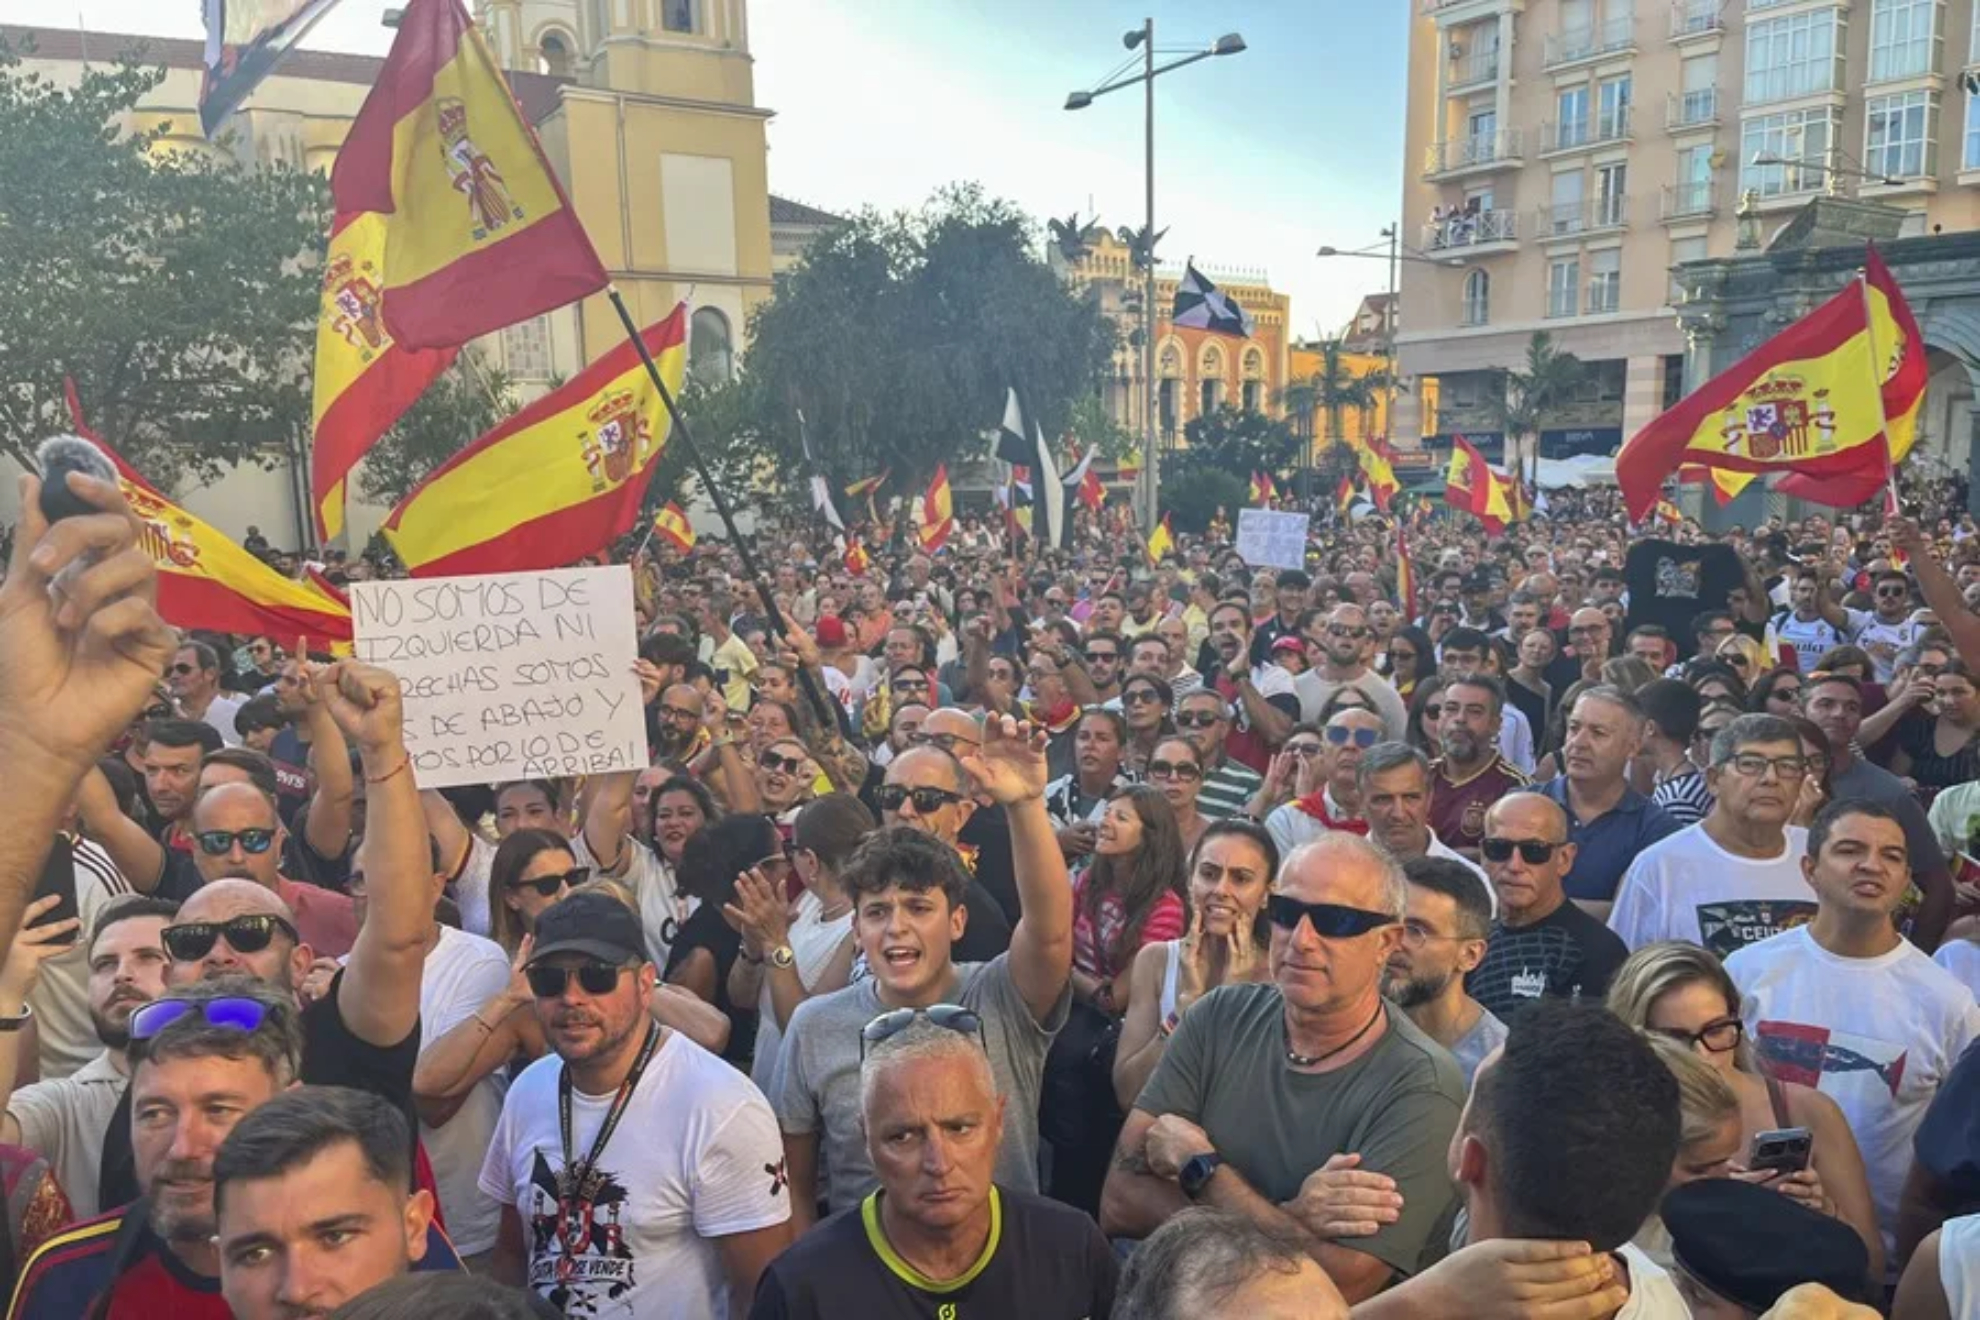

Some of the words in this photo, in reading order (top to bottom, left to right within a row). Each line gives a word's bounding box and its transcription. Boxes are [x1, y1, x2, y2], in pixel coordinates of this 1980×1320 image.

[355, 586, 402, 627] NO
[413, 581, 524, 623] SOMOS
[539, 578, 590, 610] DE
[359, 618, 540, 661] IZQUIERDA
[555, 613, 595, 640] NI
[400, 665, 500, 698] RECHAS
[512, 653, 611, 685] SOMOS
[431, 711, 467, 737] DE
[480, 696, 584, 731] ABAJO
[596, 688, 625, 719] Y
[466, 740, 514, 768] POR
[523, 740, 634, 781] ARRIBA!
